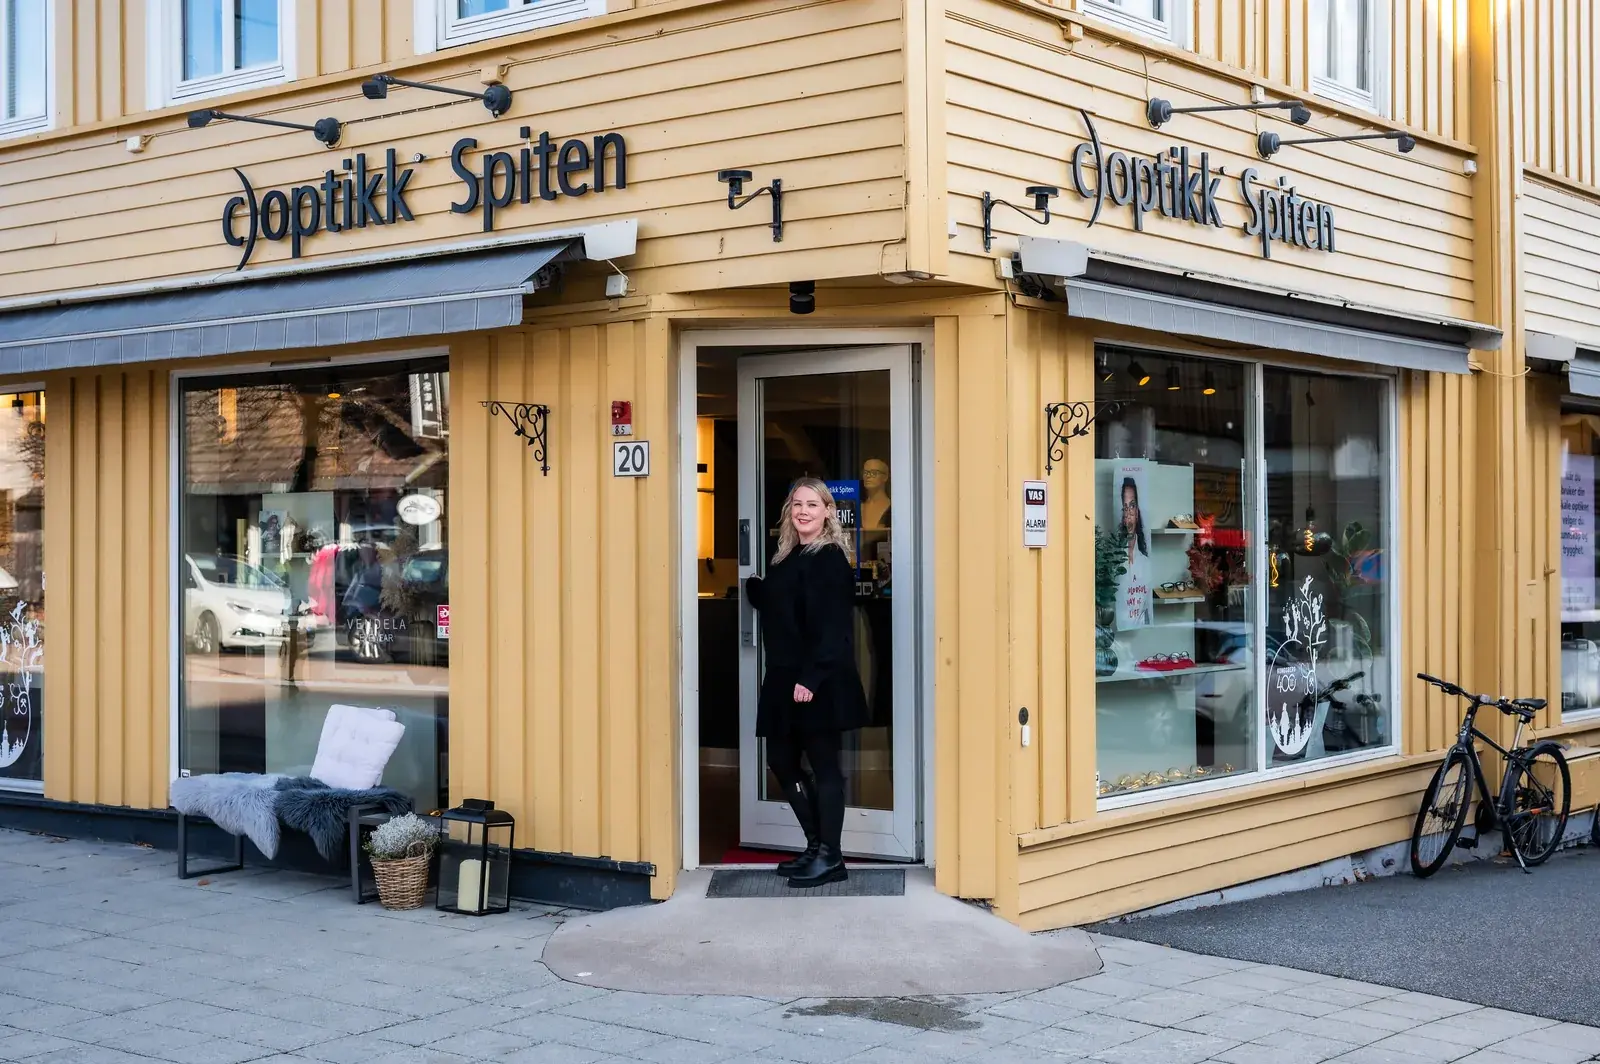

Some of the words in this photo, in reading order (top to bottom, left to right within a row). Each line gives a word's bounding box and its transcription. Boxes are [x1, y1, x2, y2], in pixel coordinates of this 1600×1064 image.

[451, 126, 627, 233] Spiten
[1241, 167, 1336, 259] Spiten
[618, 445, 645, 472] 20
[839, 485, 855, 494] Spiten
[1026, 519, 1046, 528] ALARM
[346, 618, 407, 630] VENDELA
